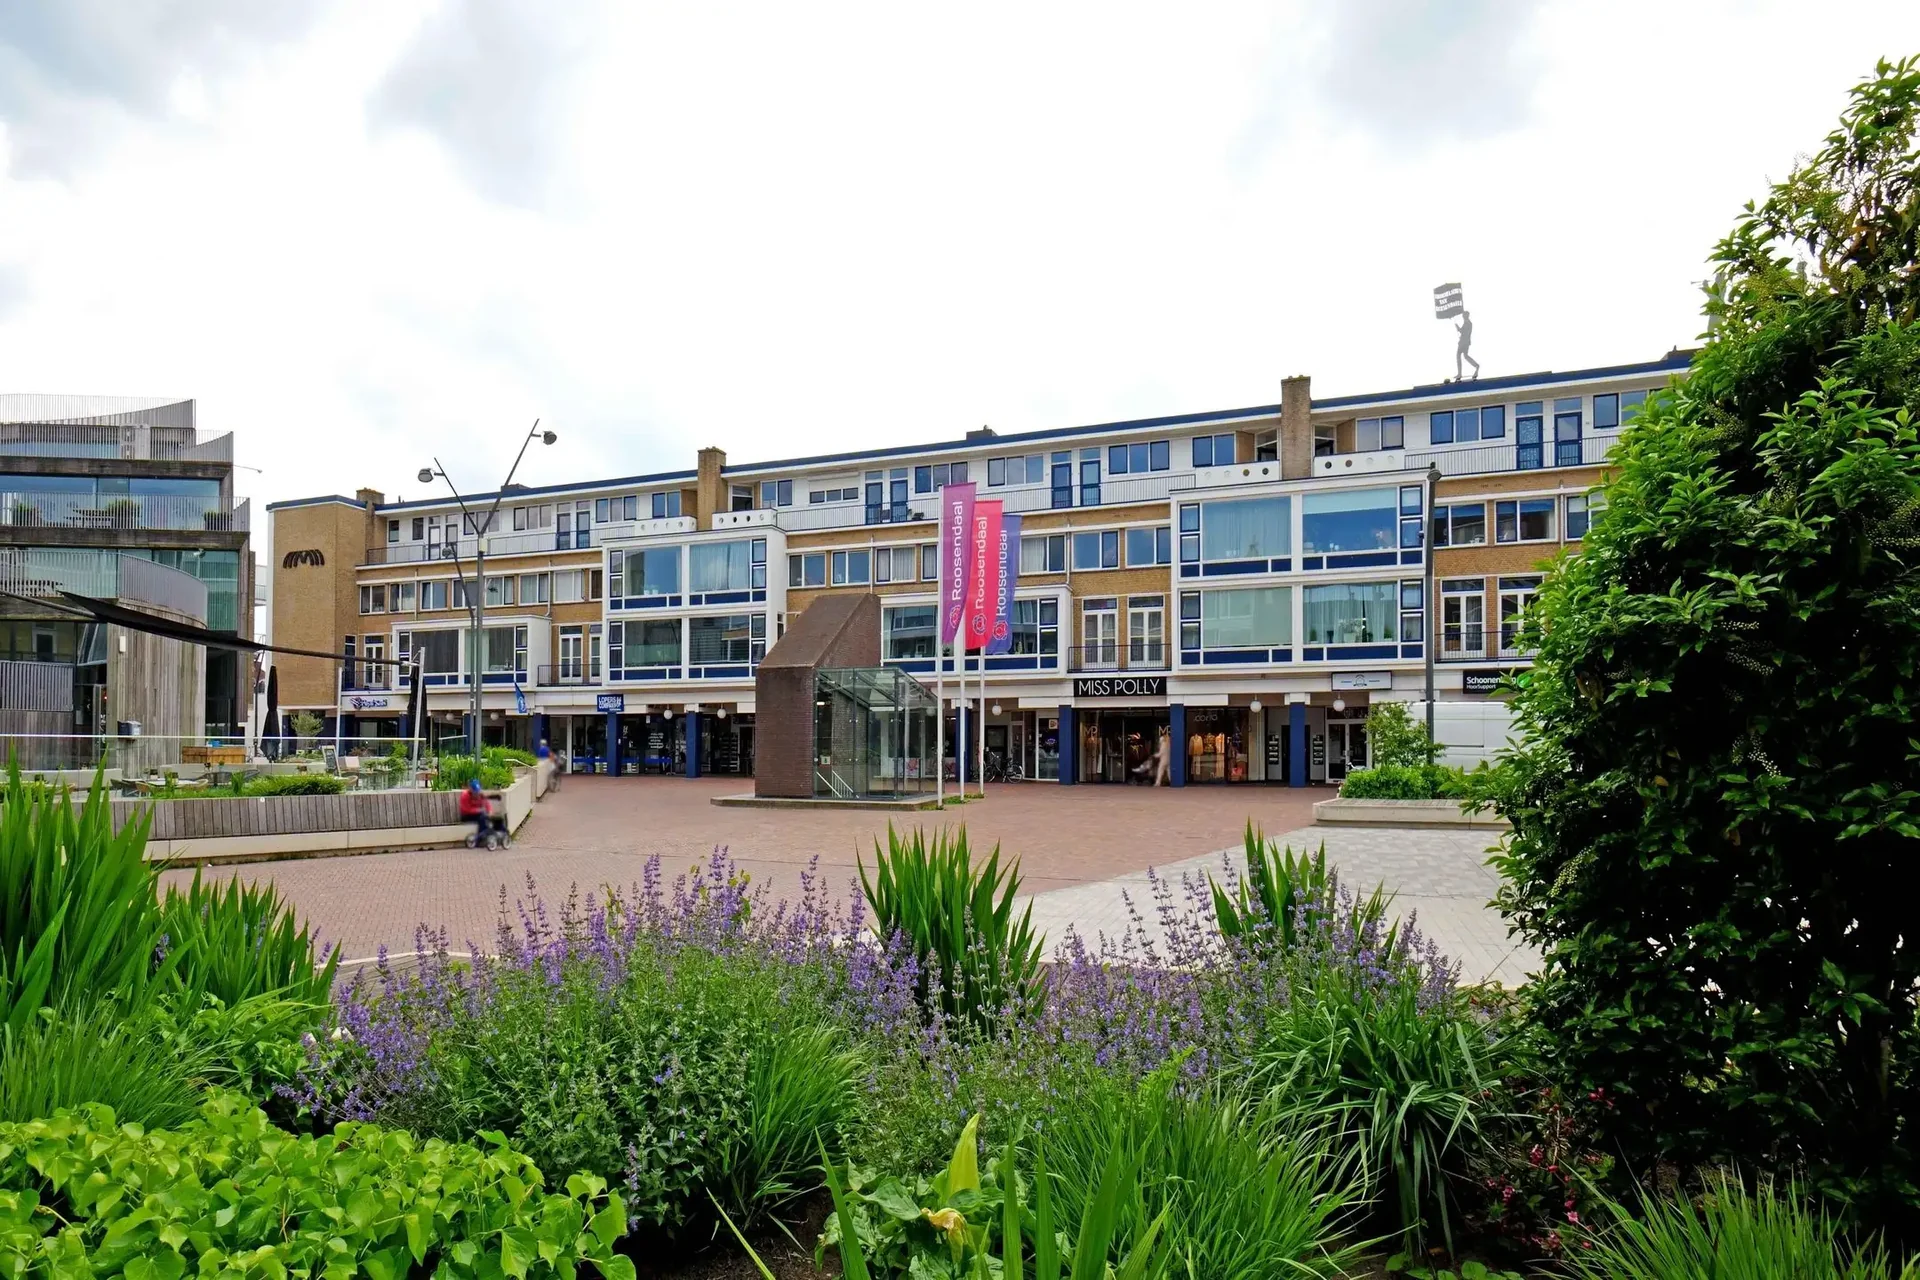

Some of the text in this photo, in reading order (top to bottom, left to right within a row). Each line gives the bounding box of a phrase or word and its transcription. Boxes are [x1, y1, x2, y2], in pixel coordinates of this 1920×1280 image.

[952, 501, 963, 600] Roosendaal
[975, 516, 988, 609] Roosendaal
[1079, 679, 1160, 695] MISS POLLY
[1466, 676, 1517, 685] Schooneng
